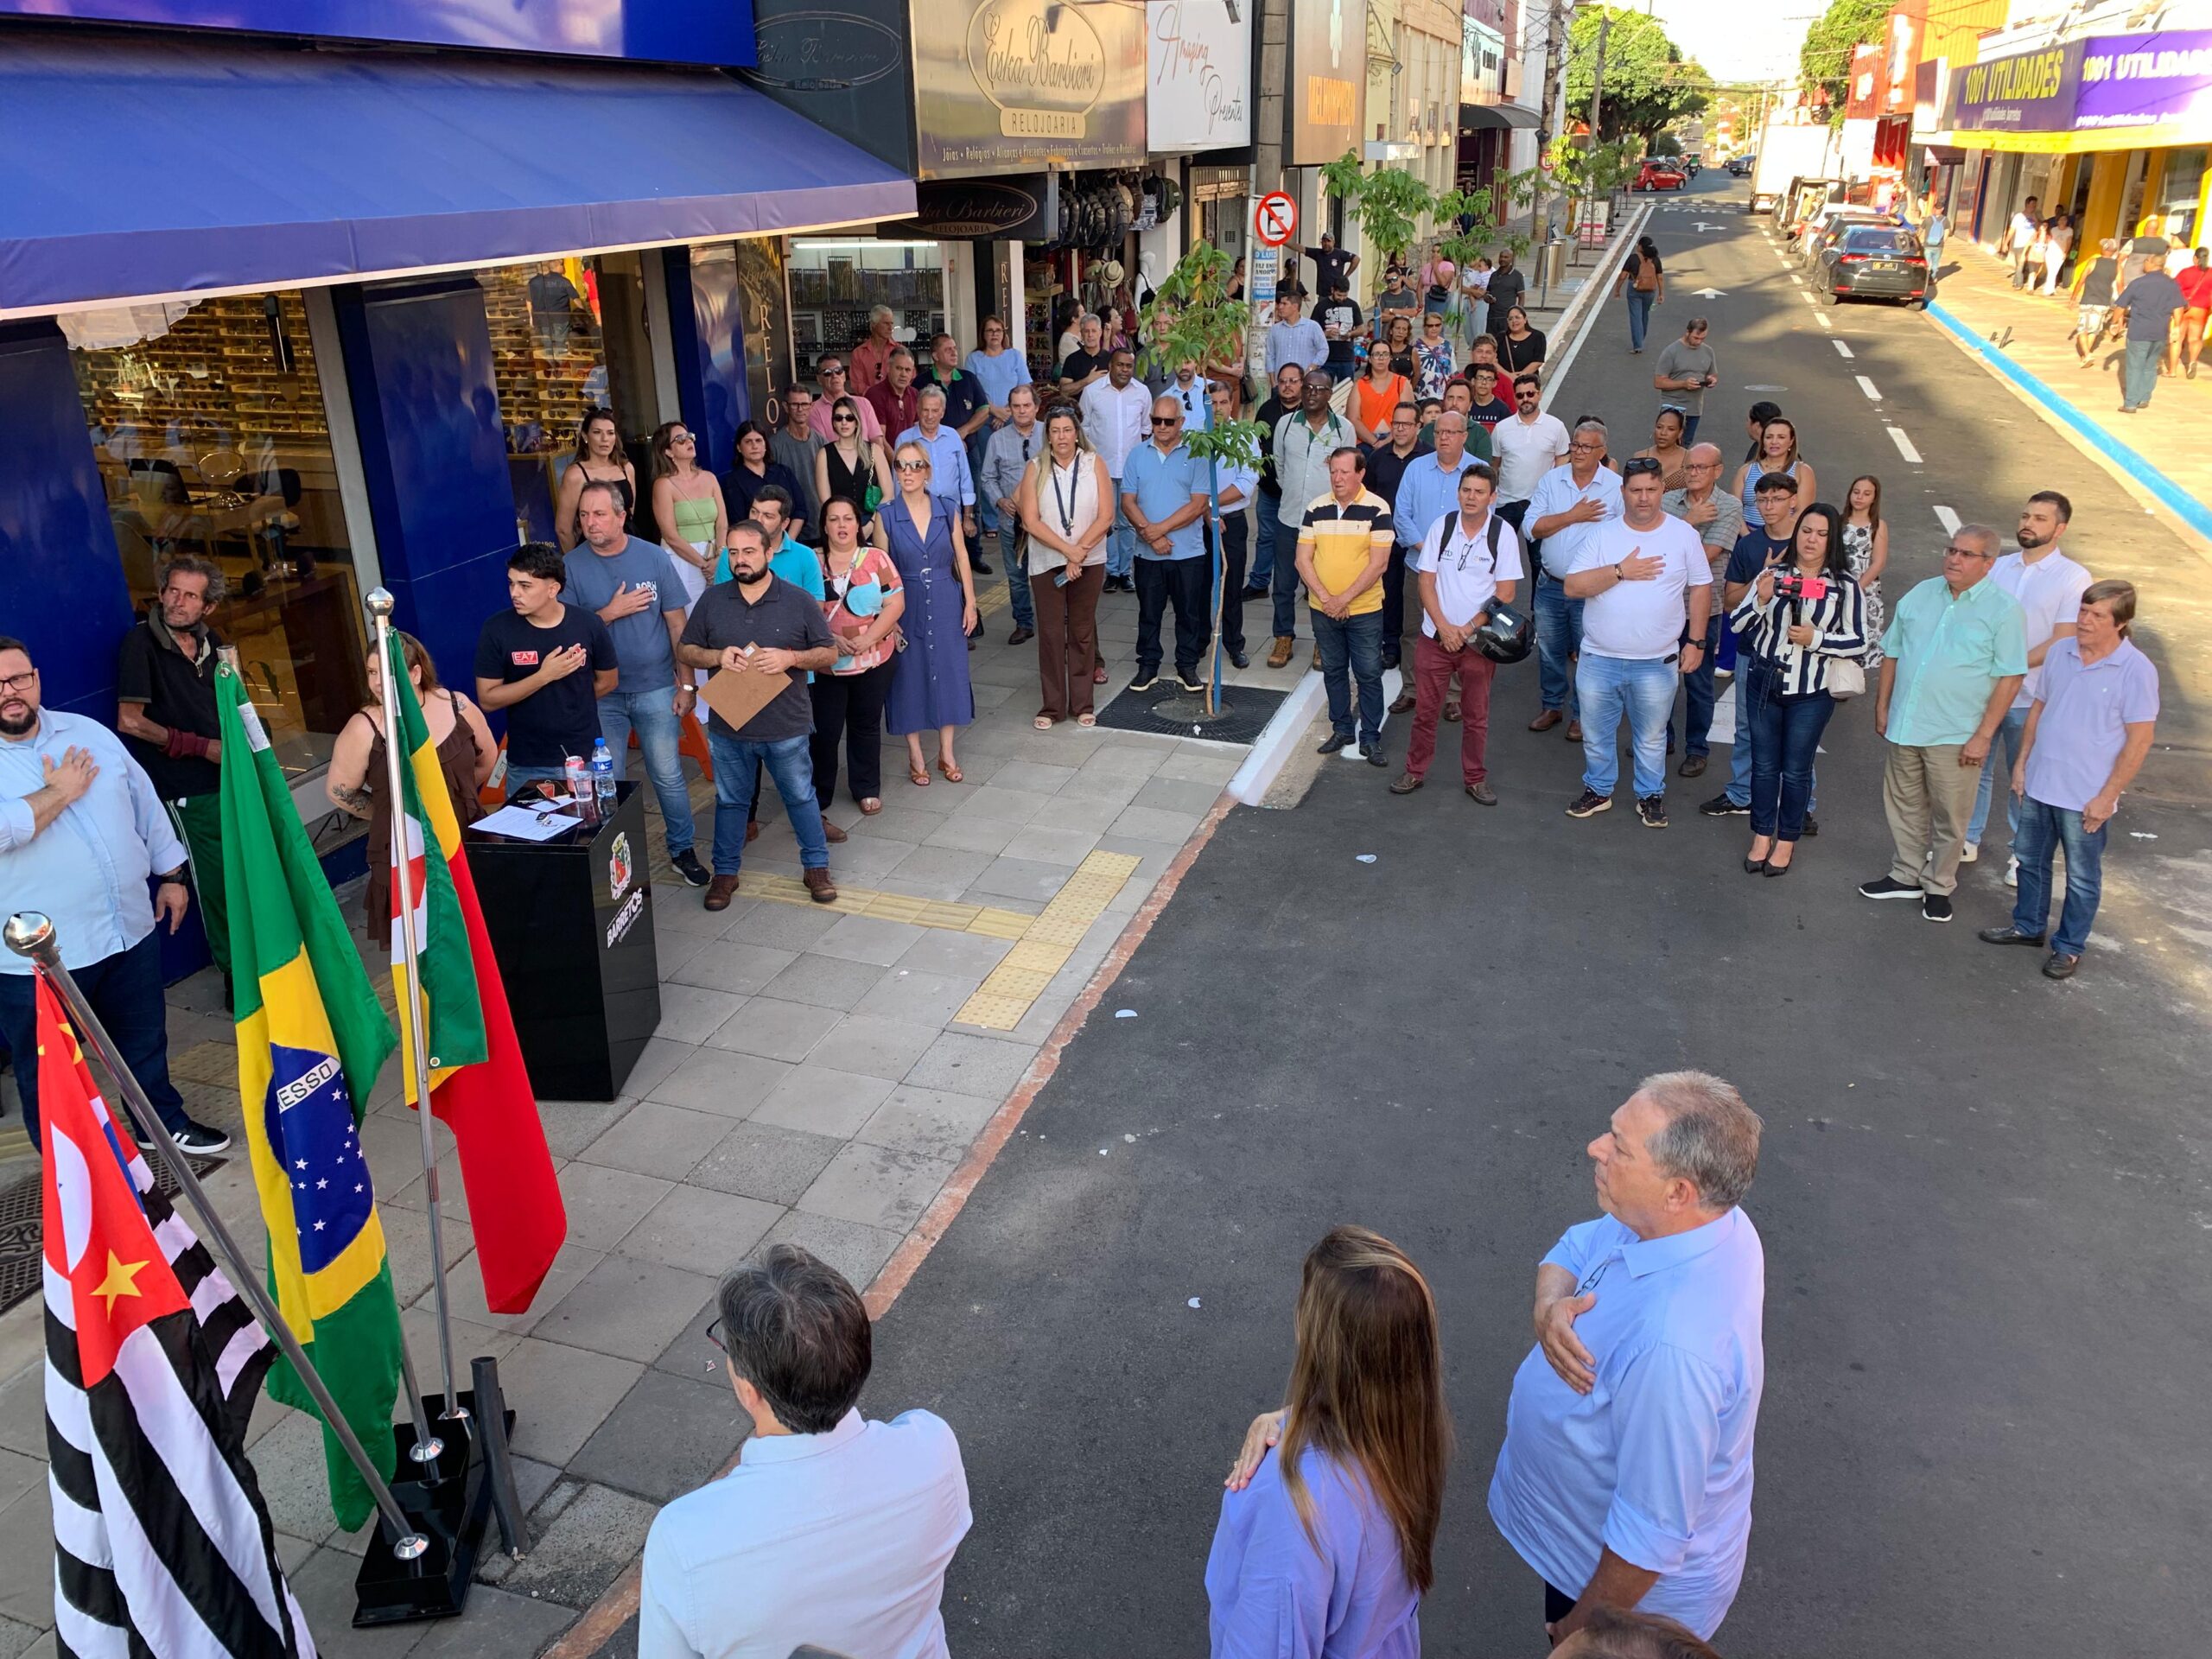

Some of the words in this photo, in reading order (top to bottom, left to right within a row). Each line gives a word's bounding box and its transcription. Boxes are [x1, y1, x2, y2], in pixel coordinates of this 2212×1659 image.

[1027, 15, 1095, 91] Barbieri
[2082, 55, 2113, 82] 1001
[1964, 64, 1988, 105] 1001
[1987, 48, 2064, 102] UTILIDADES
[1011, 112, 1077, 133] RELOJOARIA
[1205, 73, 1243, 136] Presentes
[946, 197, 1026, 219] Barbieri
[931, 224, 991, 234] RELOJOARIA
[759, 304, 780, 434] RELO
[635, 581, 657, 591] BORN
[514, 652, 536, 661] EA7
[607, 887, 643, 949] BARRETOS
[279, 1063, 333, 1109] ESSO
